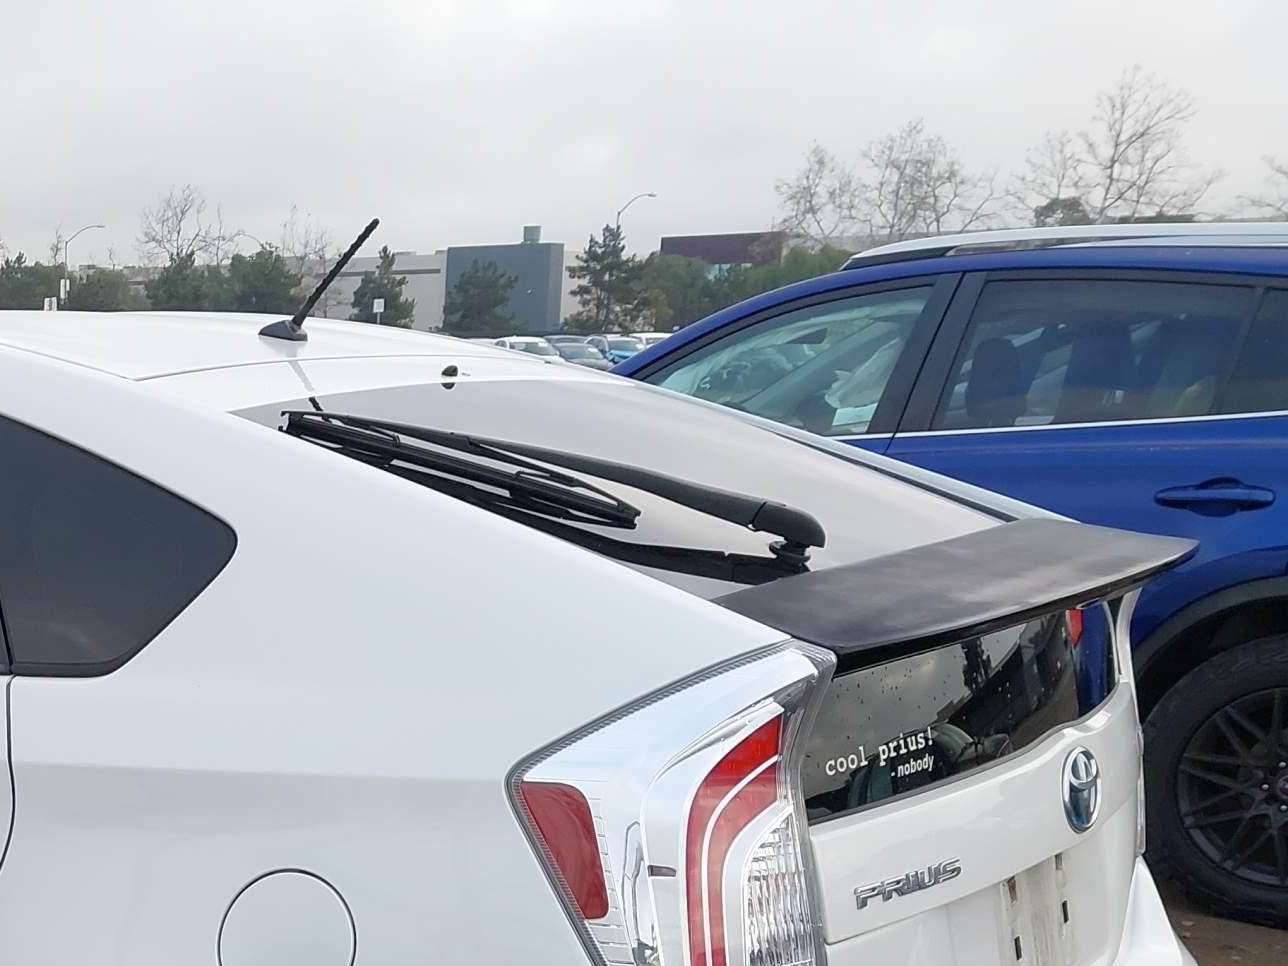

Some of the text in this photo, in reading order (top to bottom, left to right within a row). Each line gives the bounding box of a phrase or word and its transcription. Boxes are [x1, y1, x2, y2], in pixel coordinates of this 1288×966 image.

[825, 725, 934, 776] cool prius!
[853, 856, 962, 910] PRIUS
